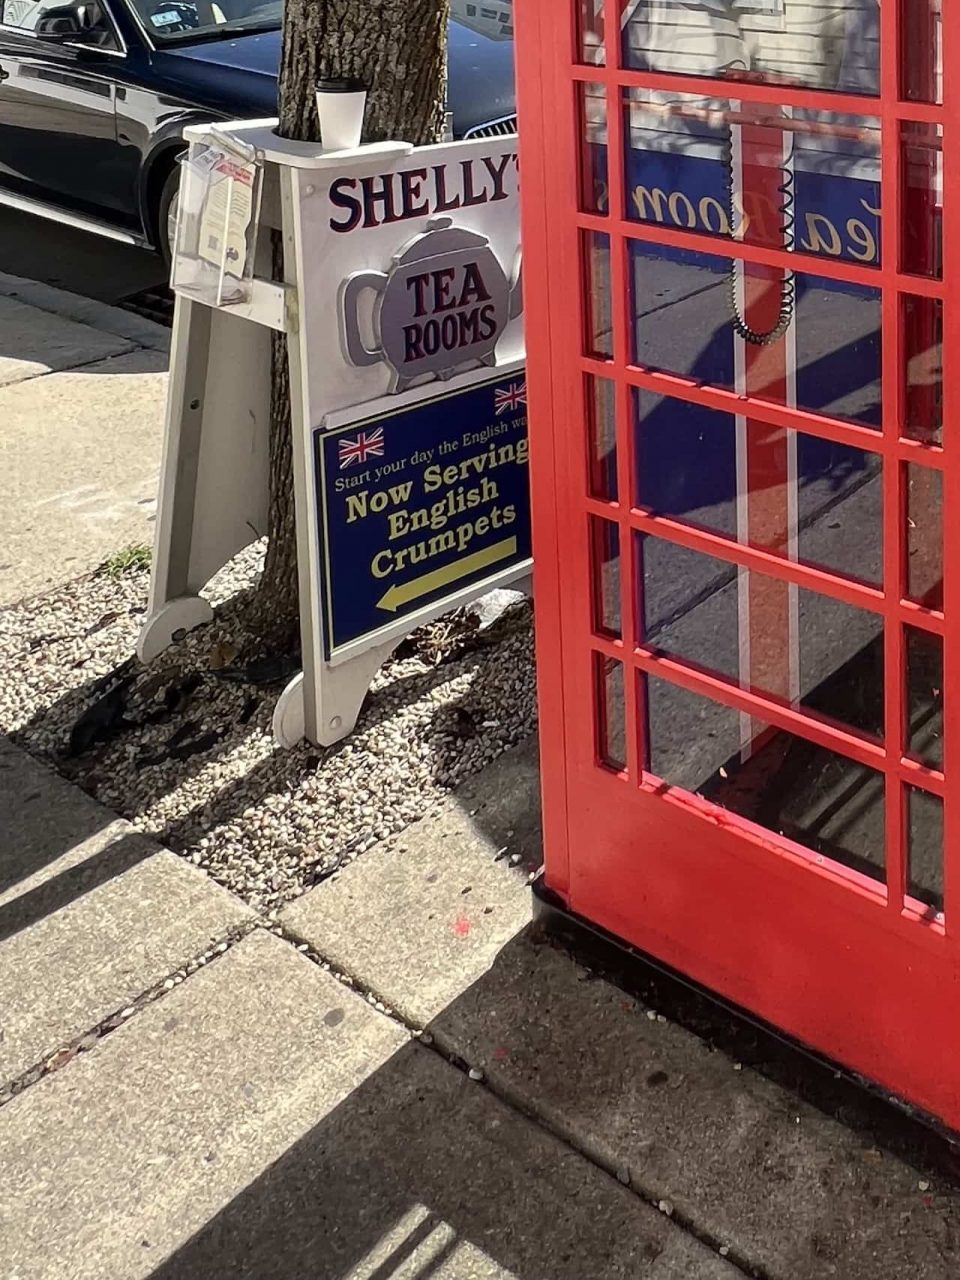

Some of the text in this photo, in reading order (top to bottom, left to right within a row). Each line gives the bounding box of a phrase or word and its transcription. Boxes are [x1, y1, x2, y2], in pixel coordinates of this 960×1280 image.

[329, 153, 520, 233] SHELLY'
[406, 262, 492, 318] TEA
[402, 304, 497, 363] ROOMS
[335, 470, 372, 492] Start
[374, 458, 407, 482] your
[410, 448, 435, 470] day
[438, 440, 459, 456] the
[462, 421, 508, 447] English
[345, 438, 529, 523] Now Serving
[371, 504, 517, 579] Crumpets
[387, 477, 499, 540] English
